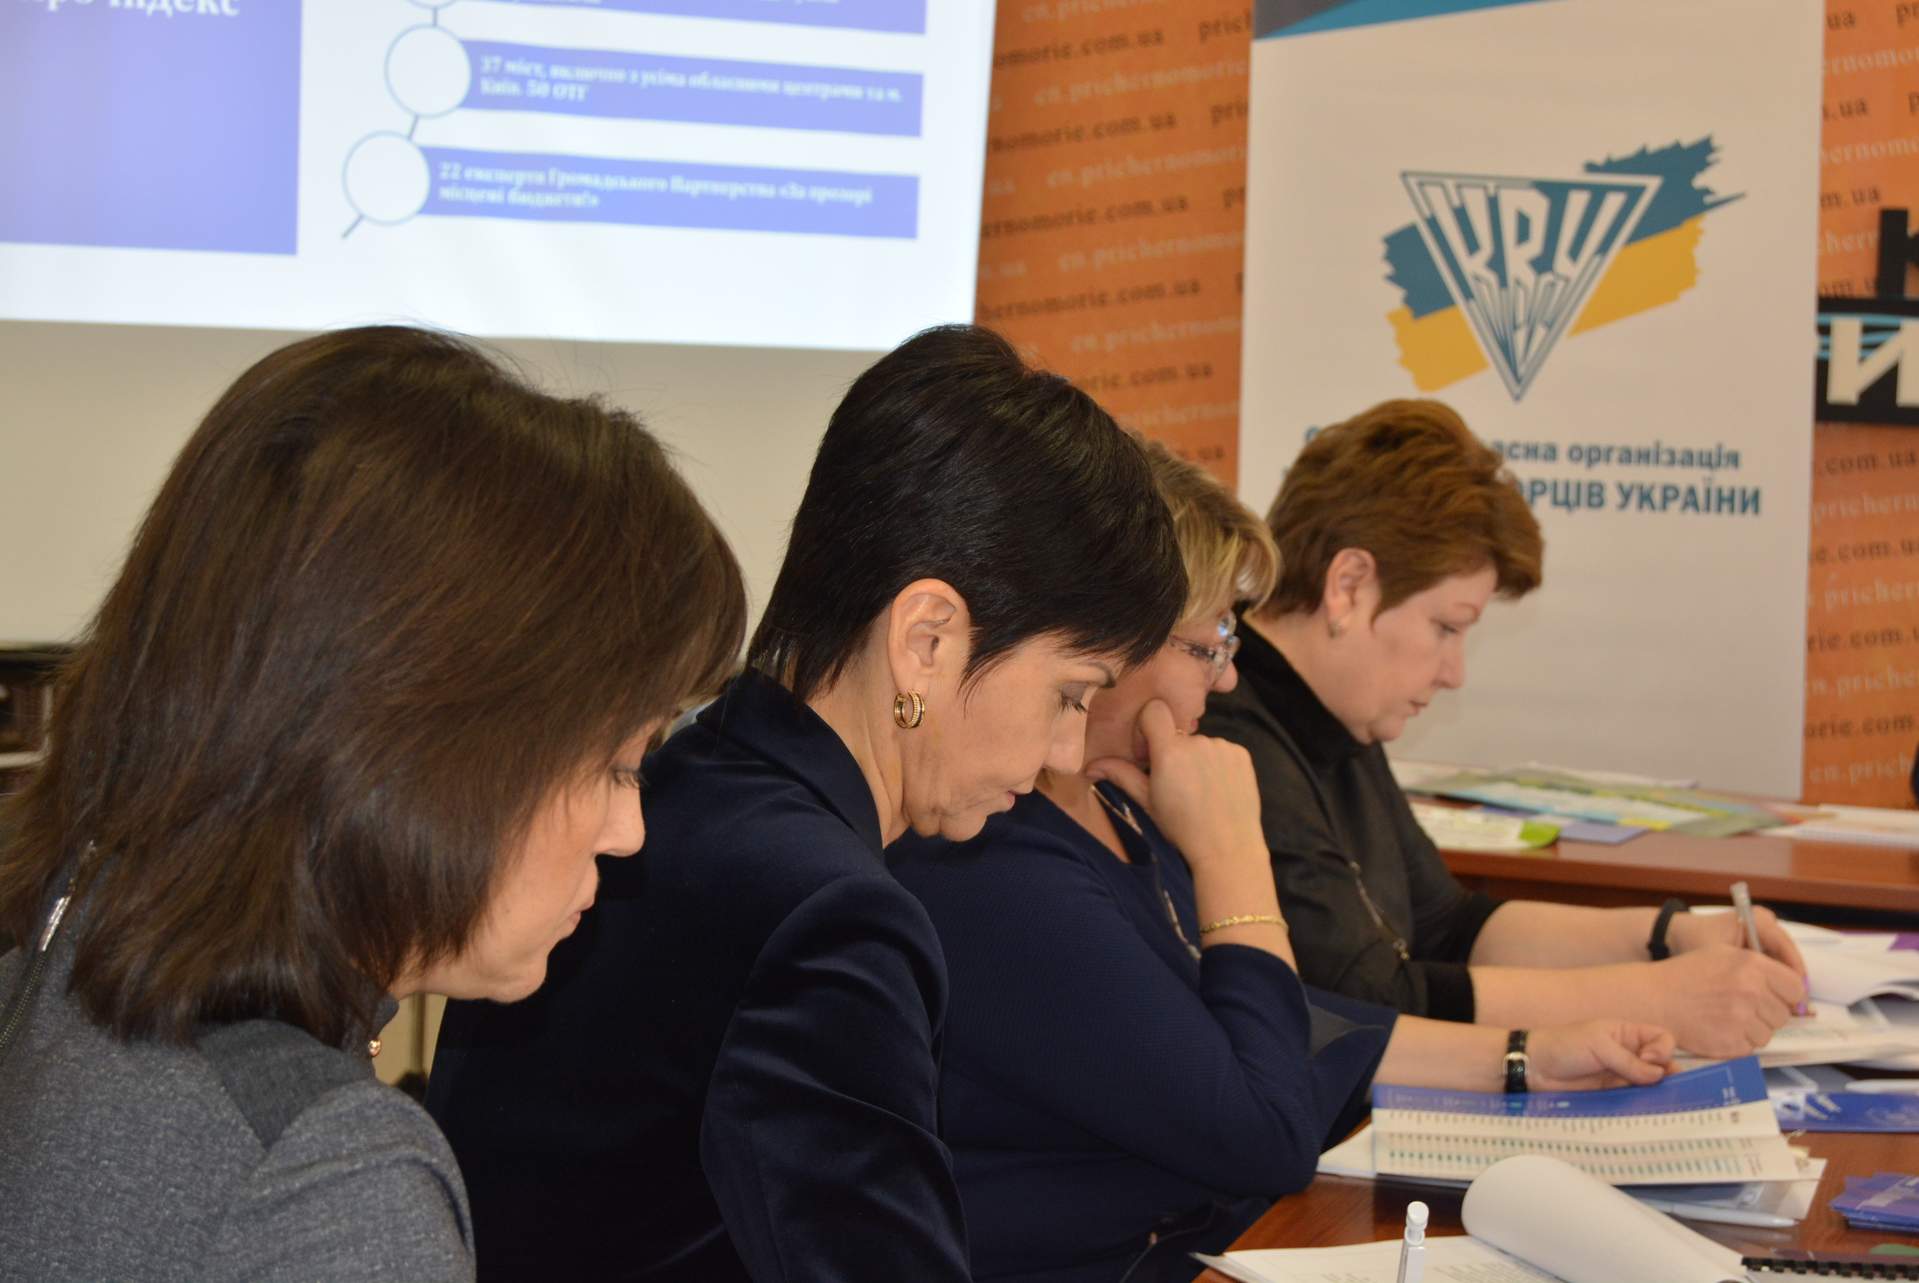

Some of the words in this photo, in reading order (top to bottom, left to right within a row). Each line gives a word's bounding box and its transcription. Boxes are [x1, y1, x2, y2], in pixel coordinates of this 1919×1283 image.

[1568, 438, 1741, 471] організація
[1518, 478, 1605, 513] РЦІВ
[1616, 474, 1761, 516] УКРАЇНИ
